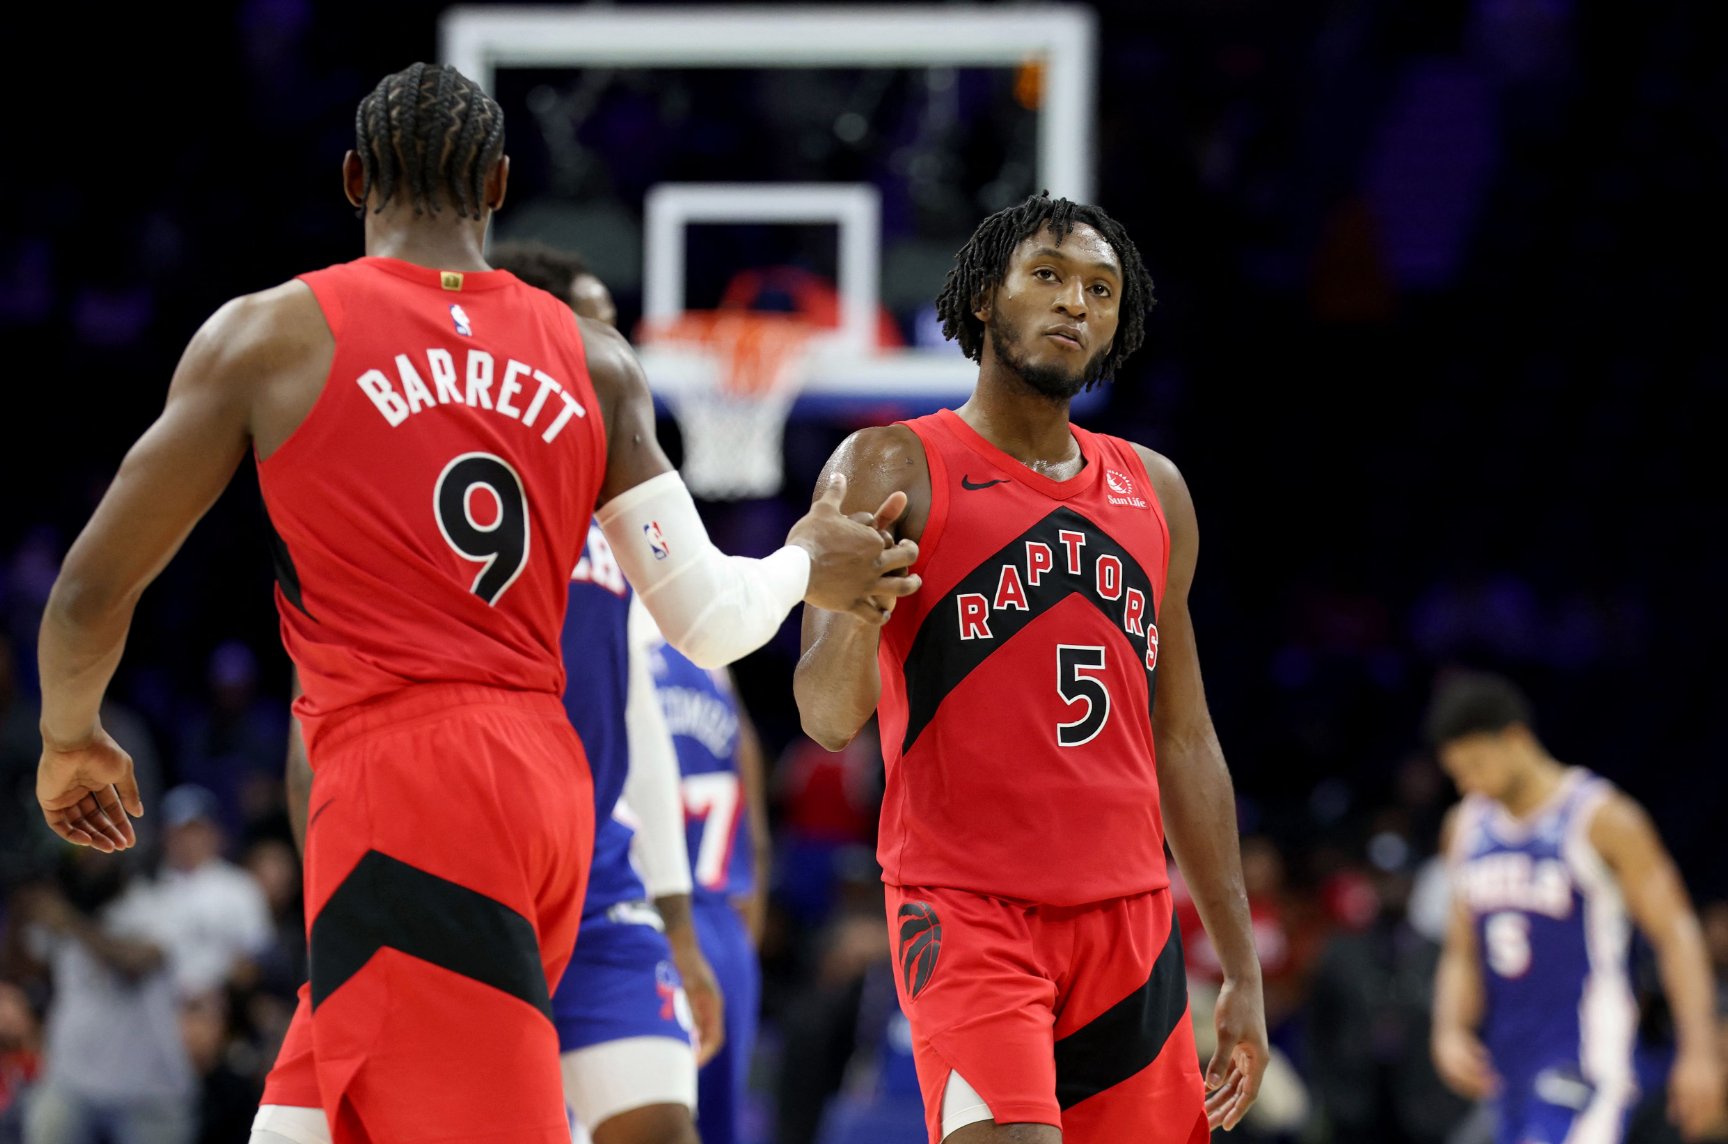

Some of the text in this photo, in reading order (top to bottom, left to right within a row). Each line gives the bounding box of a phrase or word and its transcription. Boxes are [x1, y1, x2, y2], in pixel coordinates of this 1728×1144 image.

[356, 348, 587, 444] BARRETT
[433, 451, 530, 607] 9
[1107, 494, 1148, 508] Sun Life
[957, 529, 1159, 671] RAPTORS
[1057, 643, 1110, 747] 5
